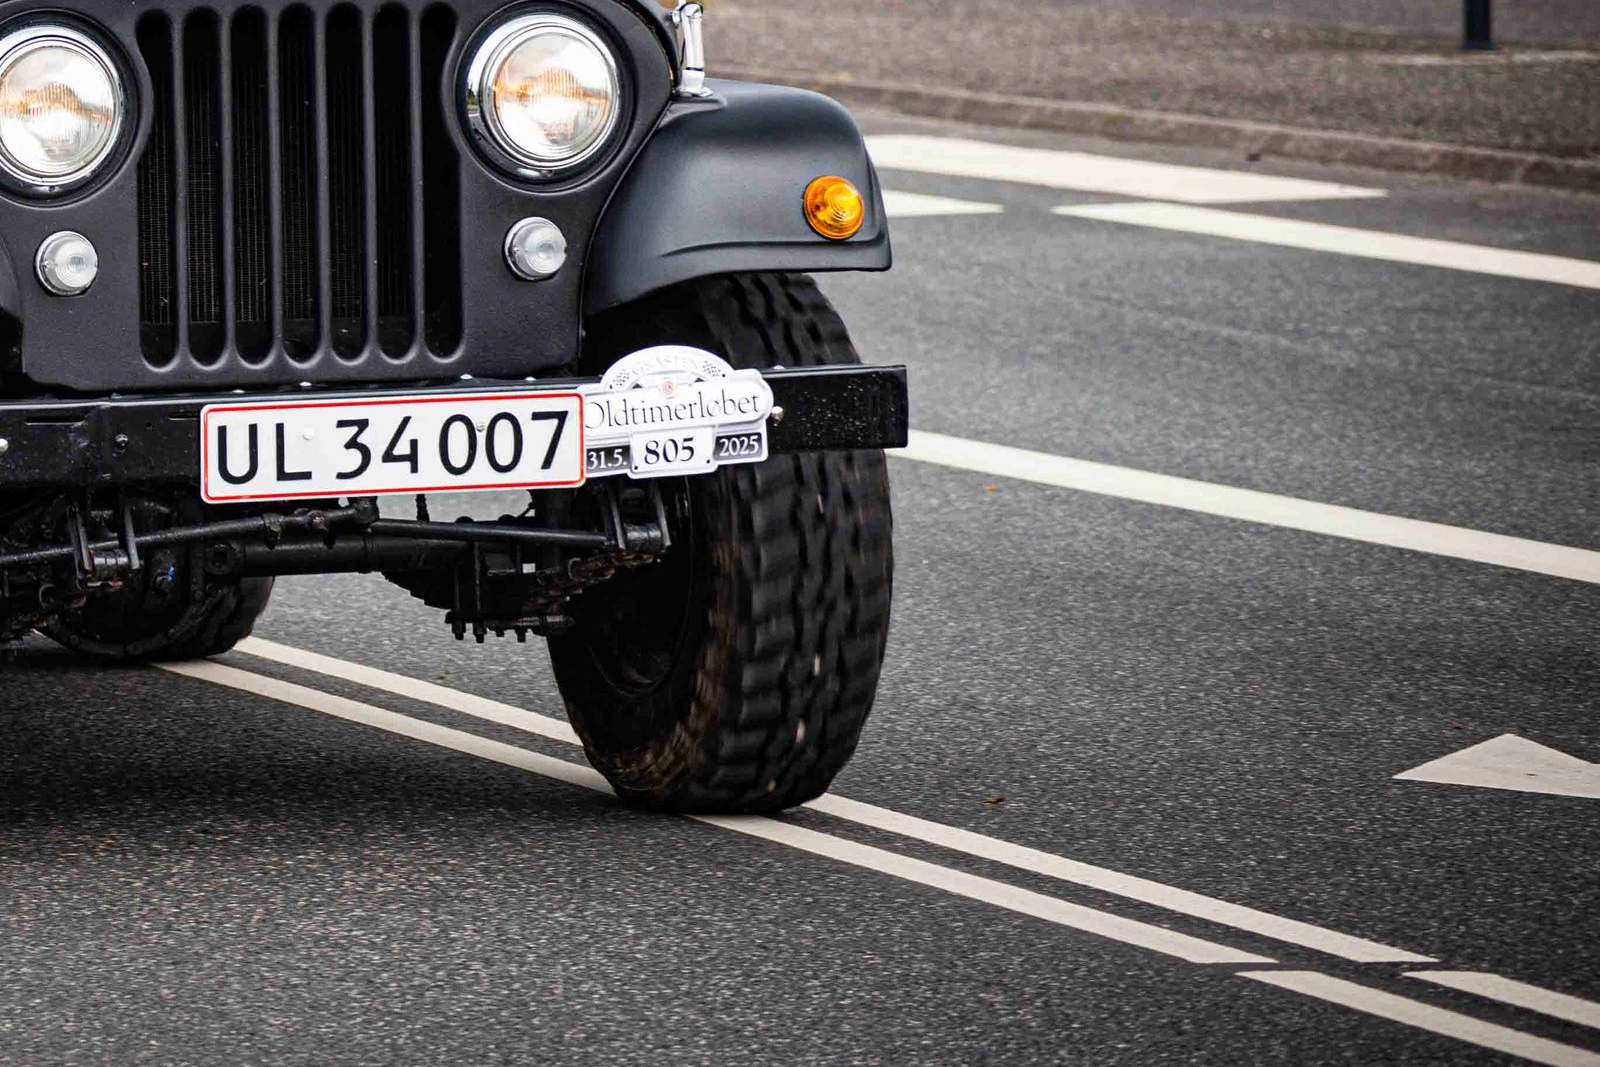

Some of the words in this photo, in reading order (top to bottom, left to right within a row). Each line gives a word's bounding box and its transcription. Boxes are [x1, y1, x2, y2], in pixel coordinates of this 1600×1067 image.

[215, 422, 313, 486] UL
[586, 446, 628, 472] 31.5.
[643, 435, 696, 466] 805
[718, 433, 760, 458] 2025
